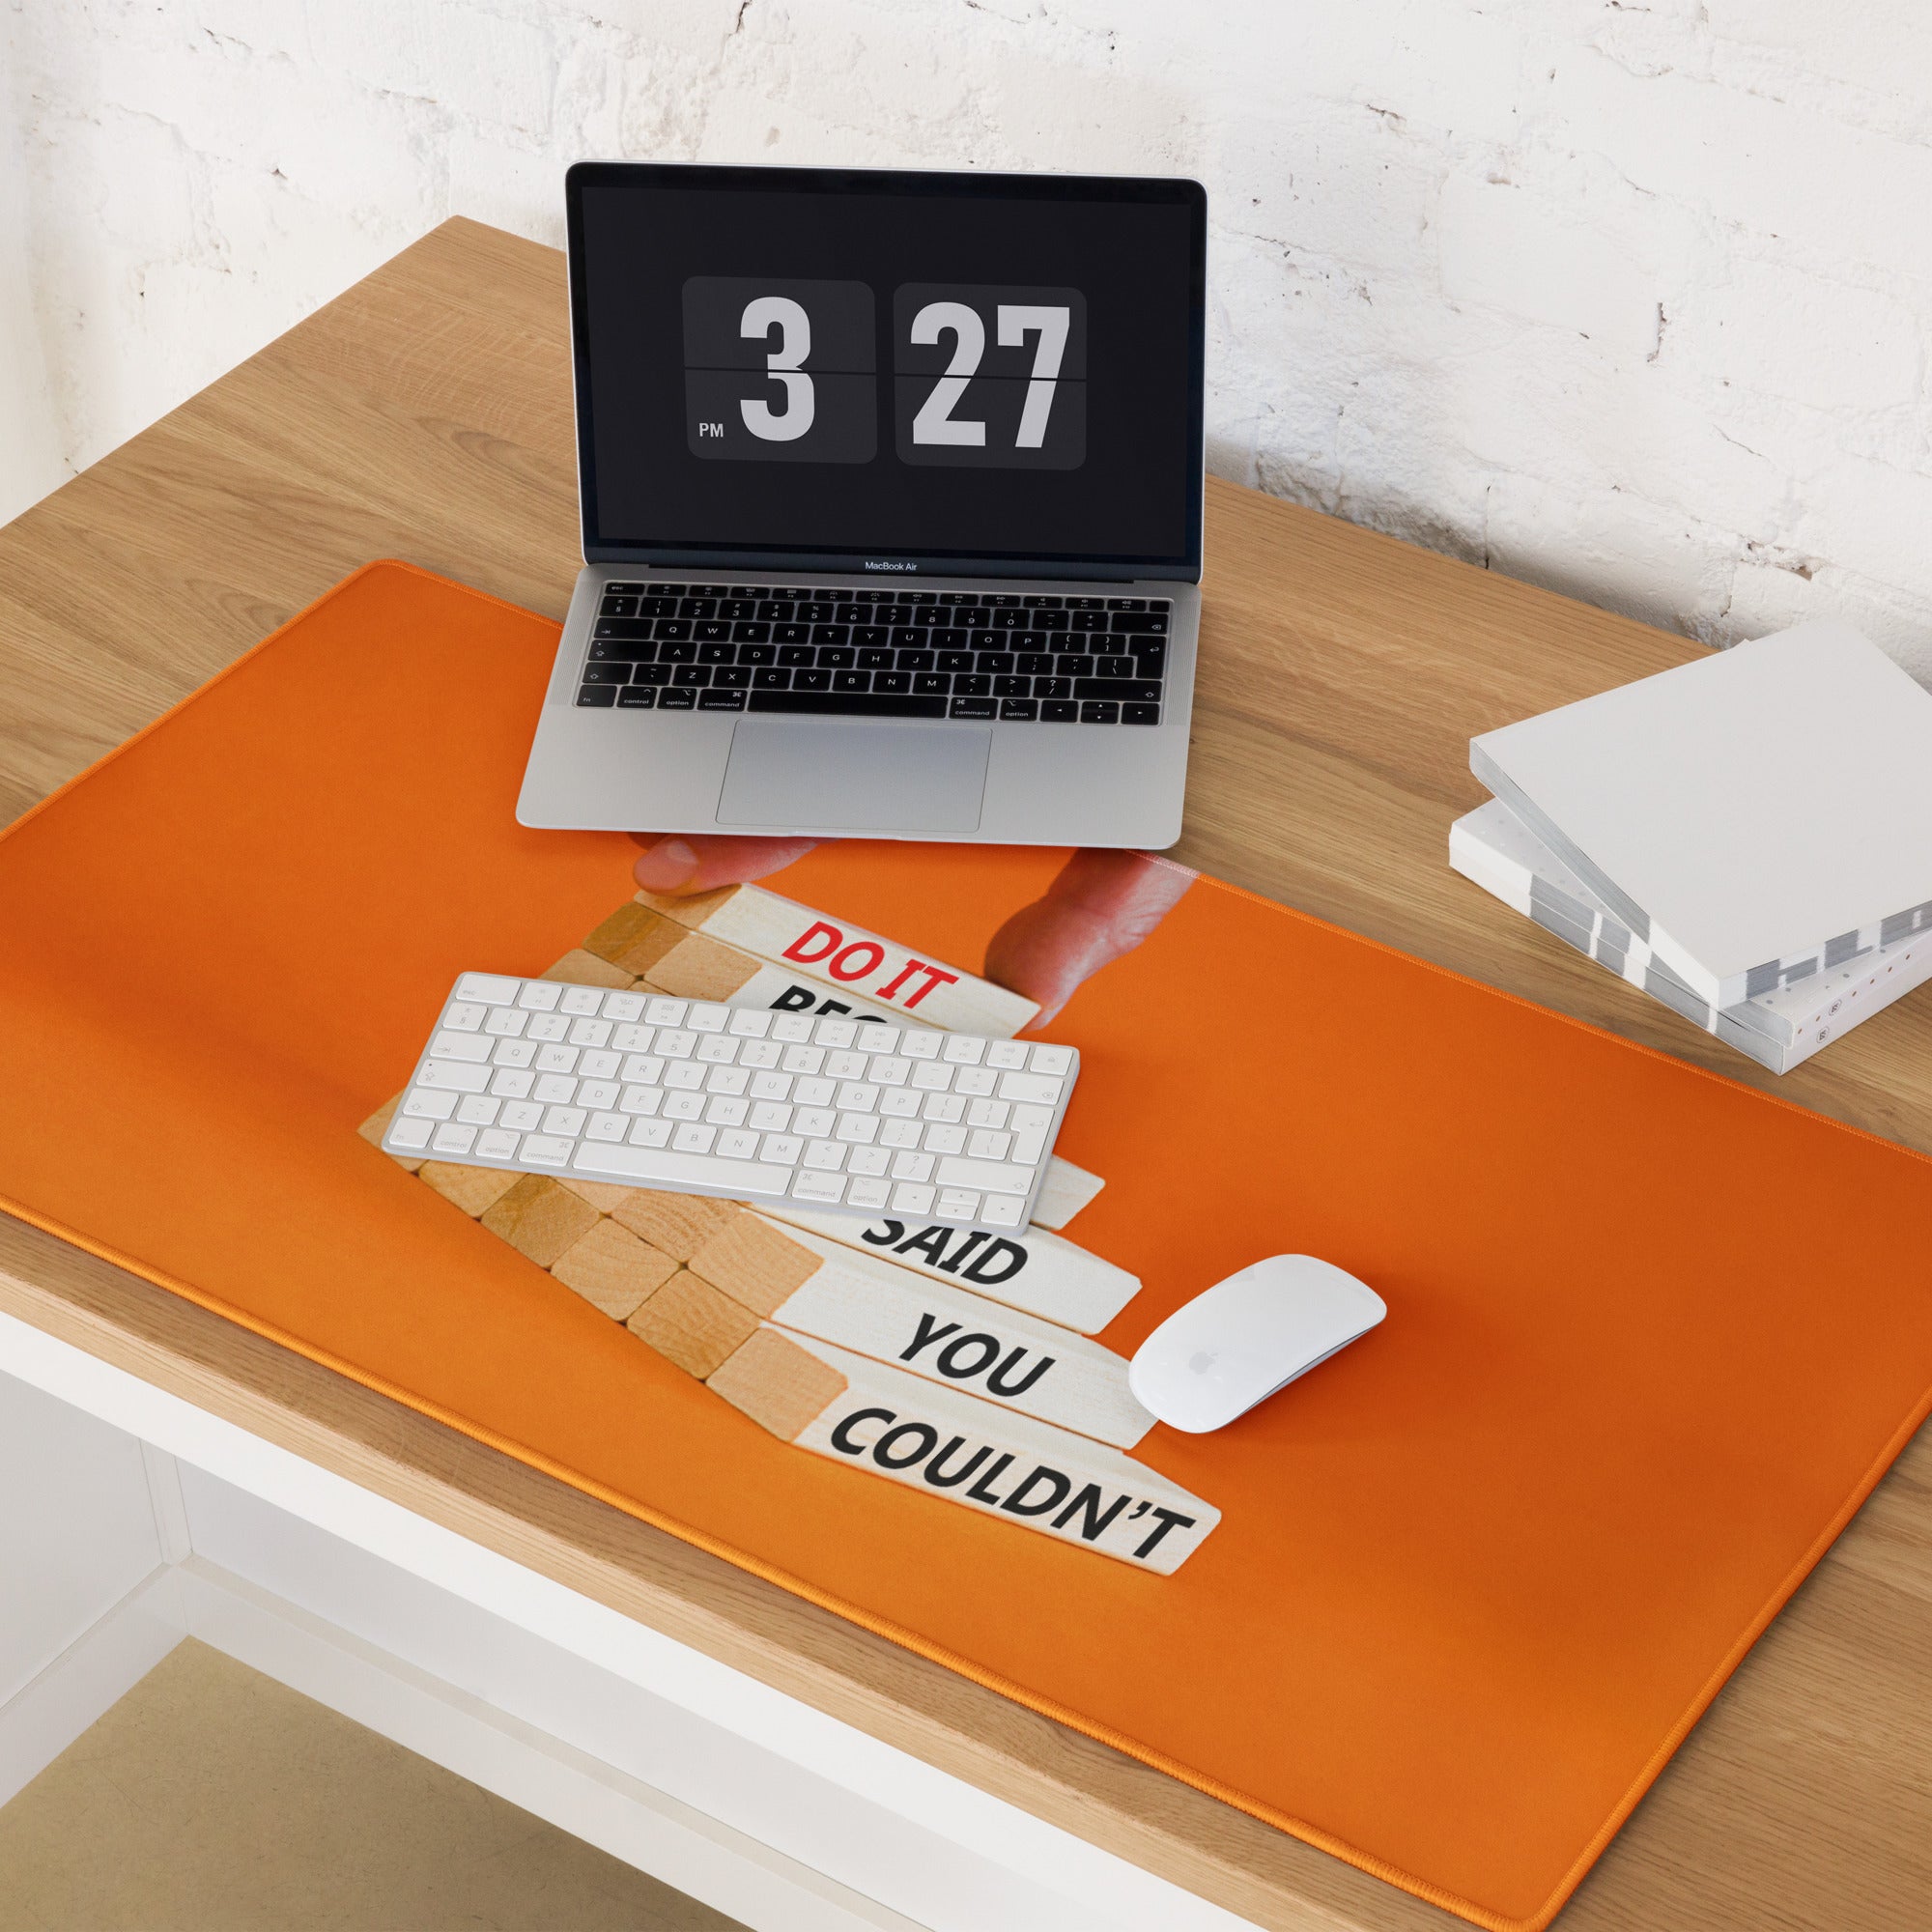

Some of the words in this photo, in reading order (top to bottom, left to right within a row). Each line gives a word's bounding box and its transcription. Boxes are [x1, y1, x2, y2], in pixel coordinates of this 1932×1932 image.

[740, 296, 815, 441] 3
[910, 301, 1070, 448] 27
[698, 422, 724, 438] PM
[865, 561, 904, 571] MacBook
[905, 562, 918, 571] Air
[623, 697, 649, 706] control
[781, 921, 886, 981] DO
[874, 958, 960, 1009] IT
[861, 1219, 1029, 1285] SAID
[898, 1312, 1057, 1397] YOU
[830, 1407, 1197, 1559] COULDN'T
